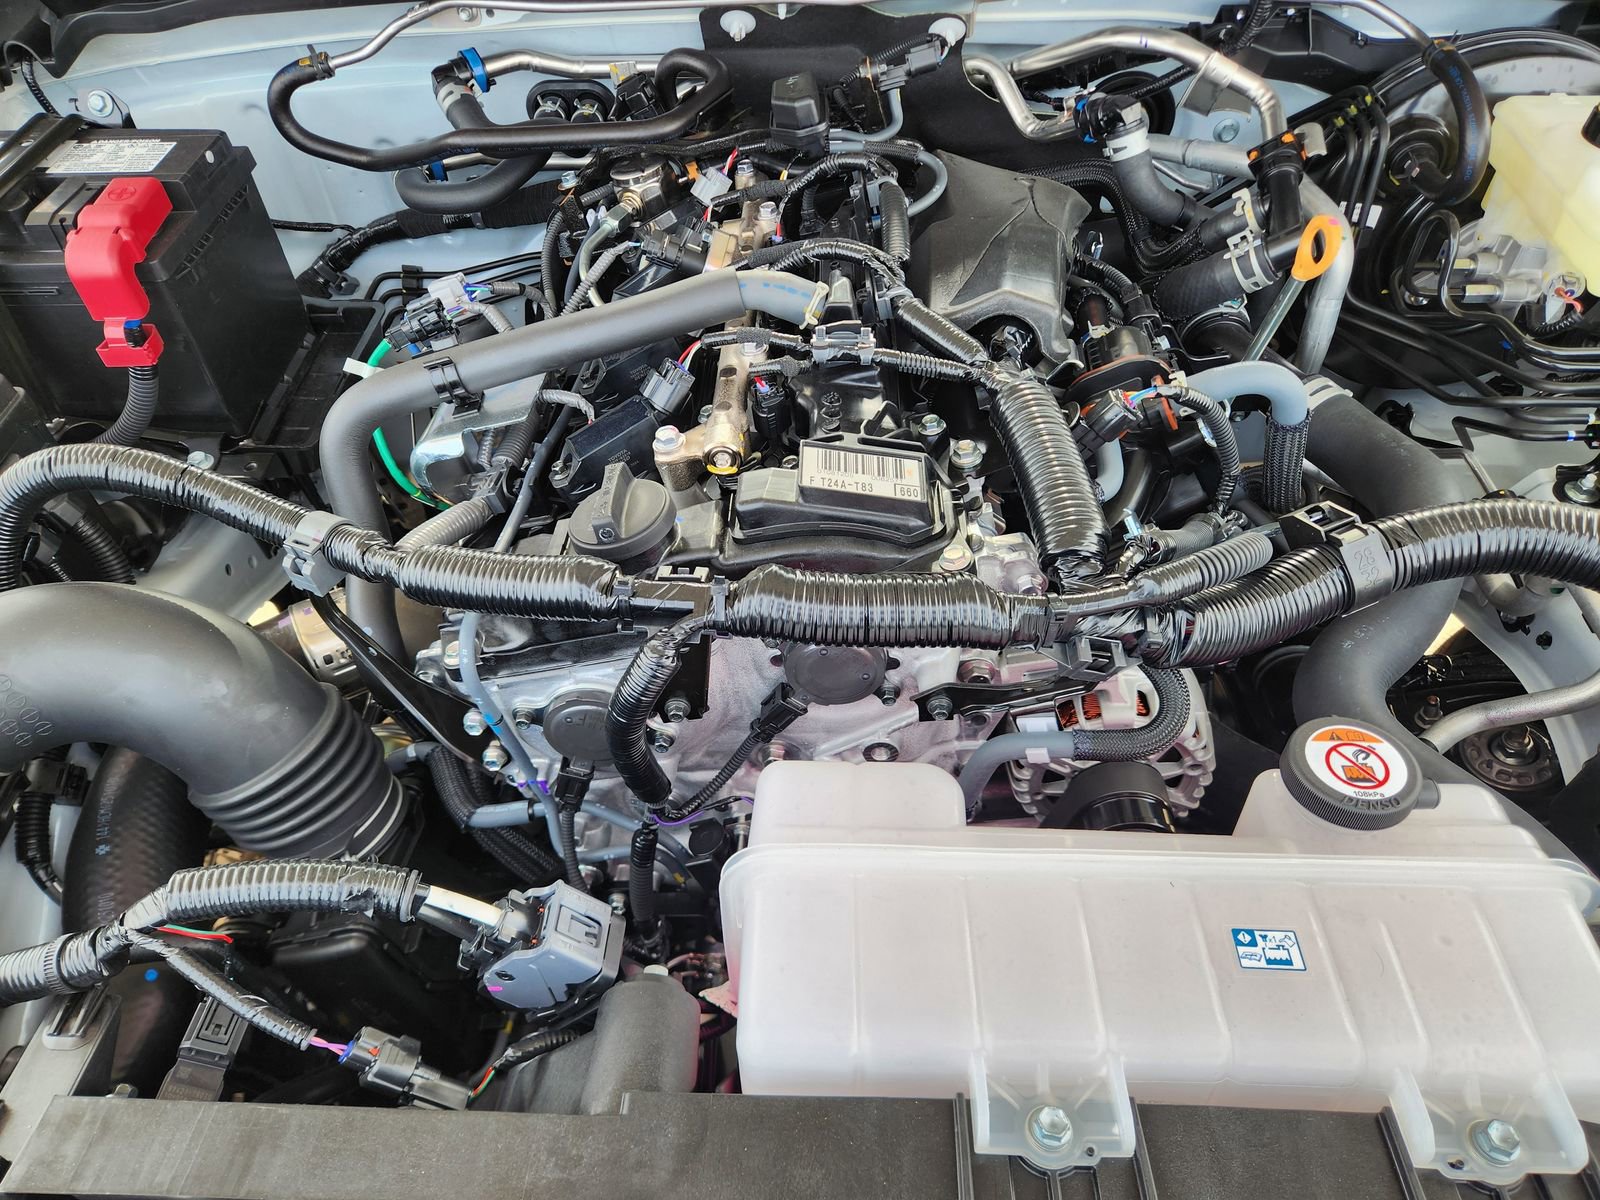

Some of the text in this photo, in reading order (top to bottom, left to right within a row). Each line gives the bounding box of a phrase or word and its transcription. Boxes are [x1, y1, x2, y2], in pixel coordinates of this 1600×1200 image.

[809, 476, 919, 498] F T24A-T83 660
[1353, 790, 1386, 798] 108kPa
[1342, 795, 1401, 811] DENSO
